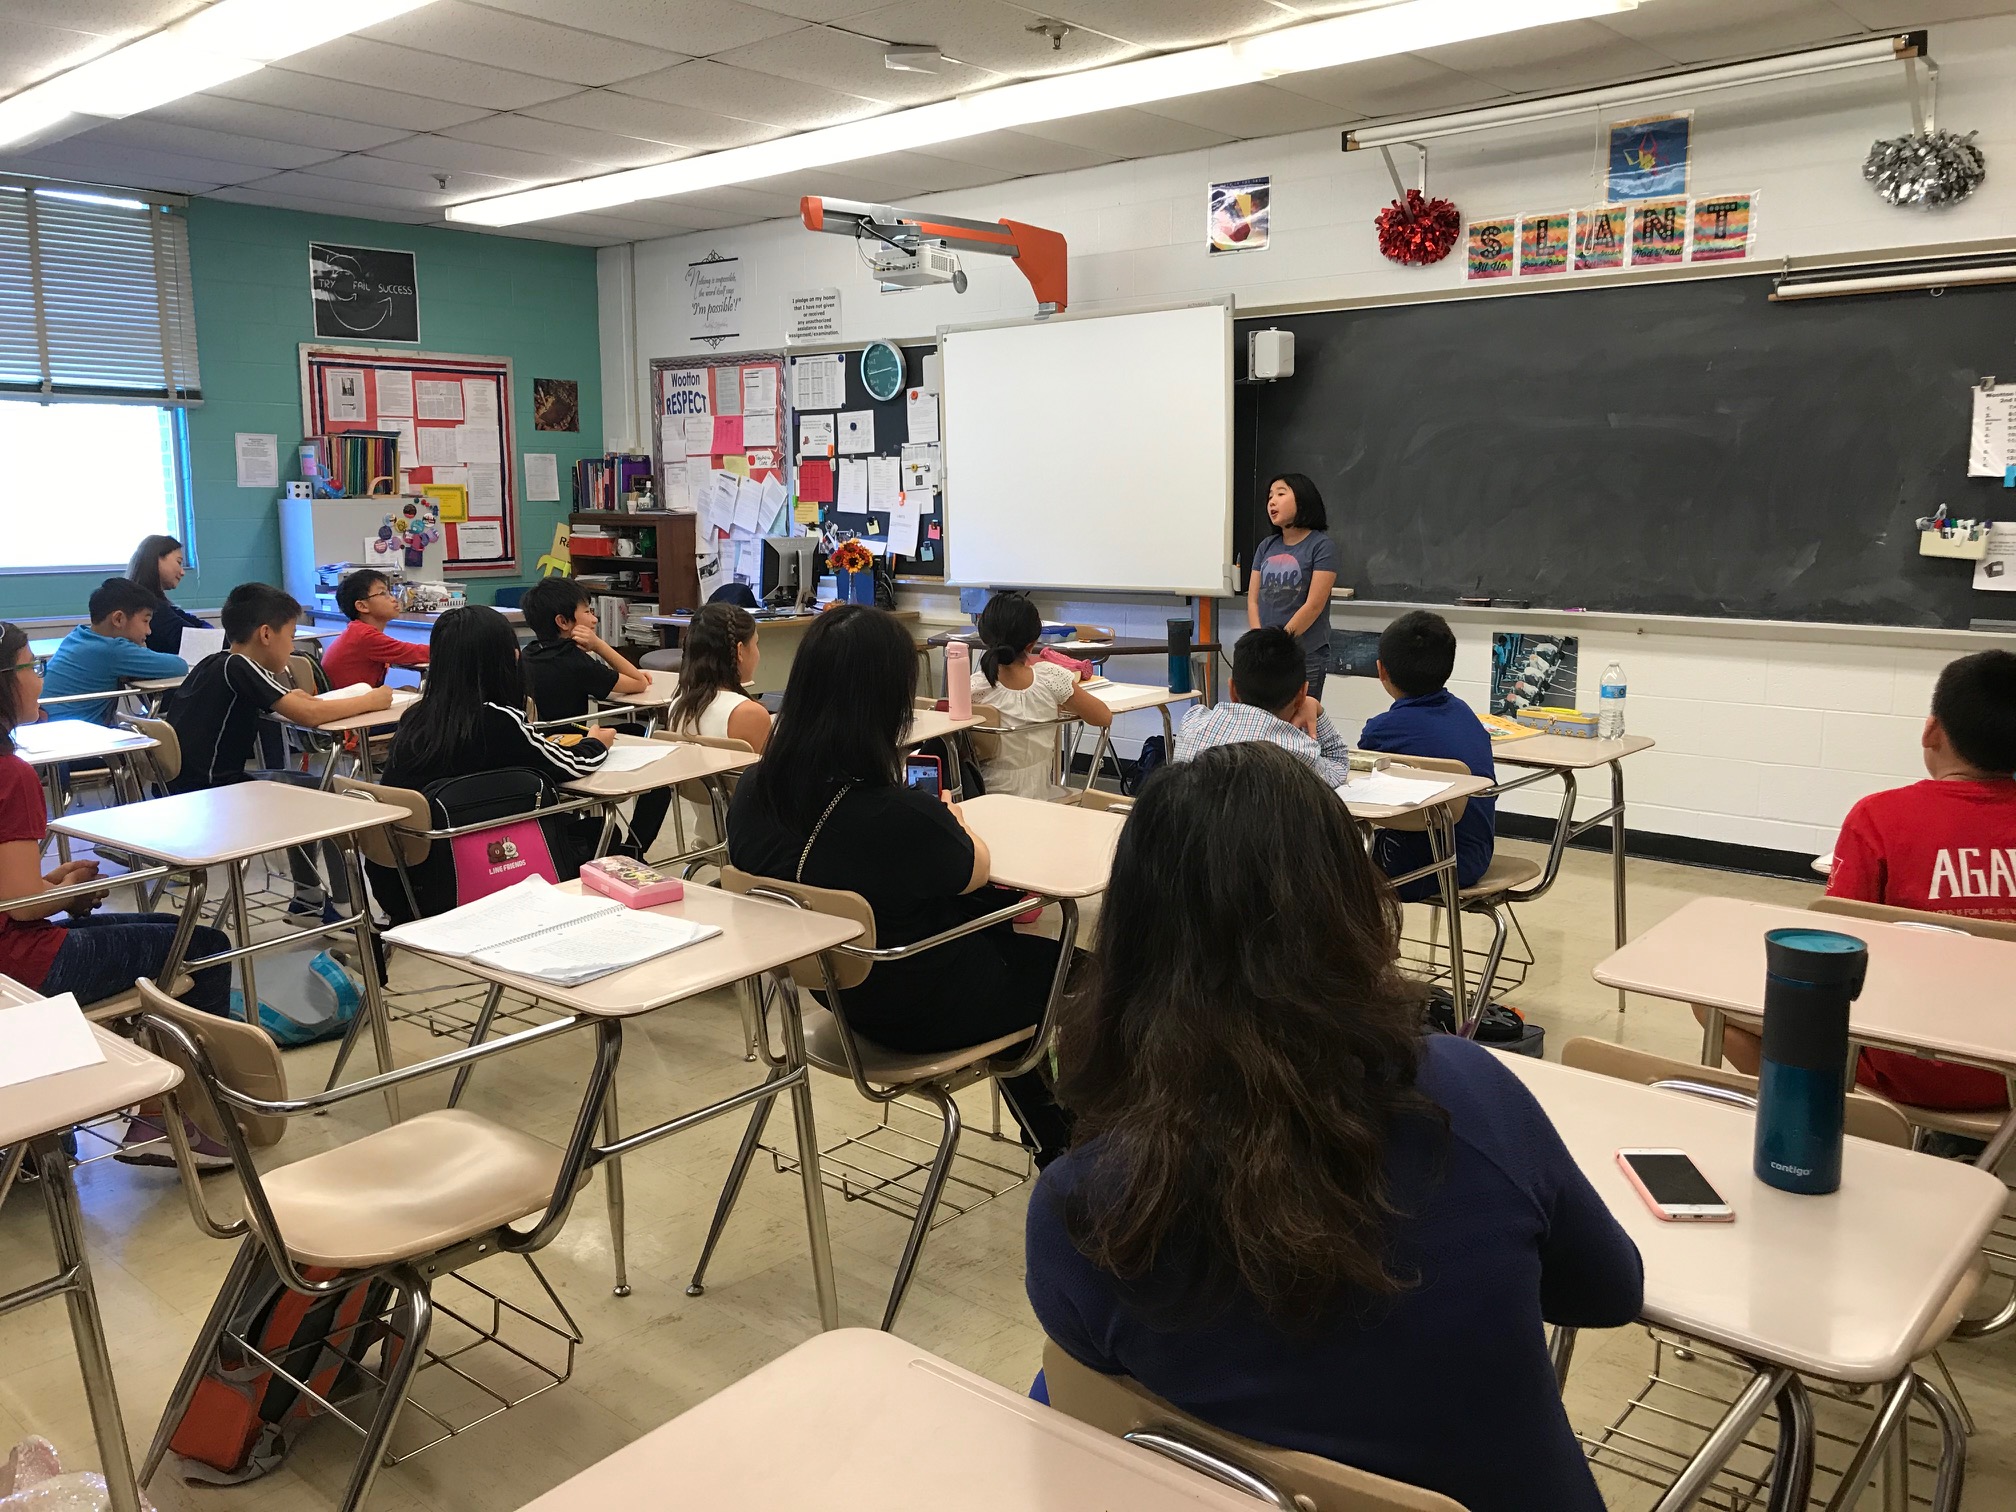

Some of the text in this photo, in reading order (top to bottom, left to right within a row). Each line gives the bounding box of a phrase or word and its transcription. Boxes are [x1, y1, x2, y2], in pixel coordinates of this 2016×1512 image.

[1474, 262, 1506, 274] Sit Up
[318, 278, 336, 289] TRY
[352, 280, 371, 292] FAIL
[378, 283, 413, 296] SUCCESS
[706, 286, 716, 297] word
[671, 372, 700, 388] Wootton
[666, 390, 707, 416] RESPECT
[503, 859, 527, 872] FRIENDS
[1770, 1161, 1811, 1177] contigo
